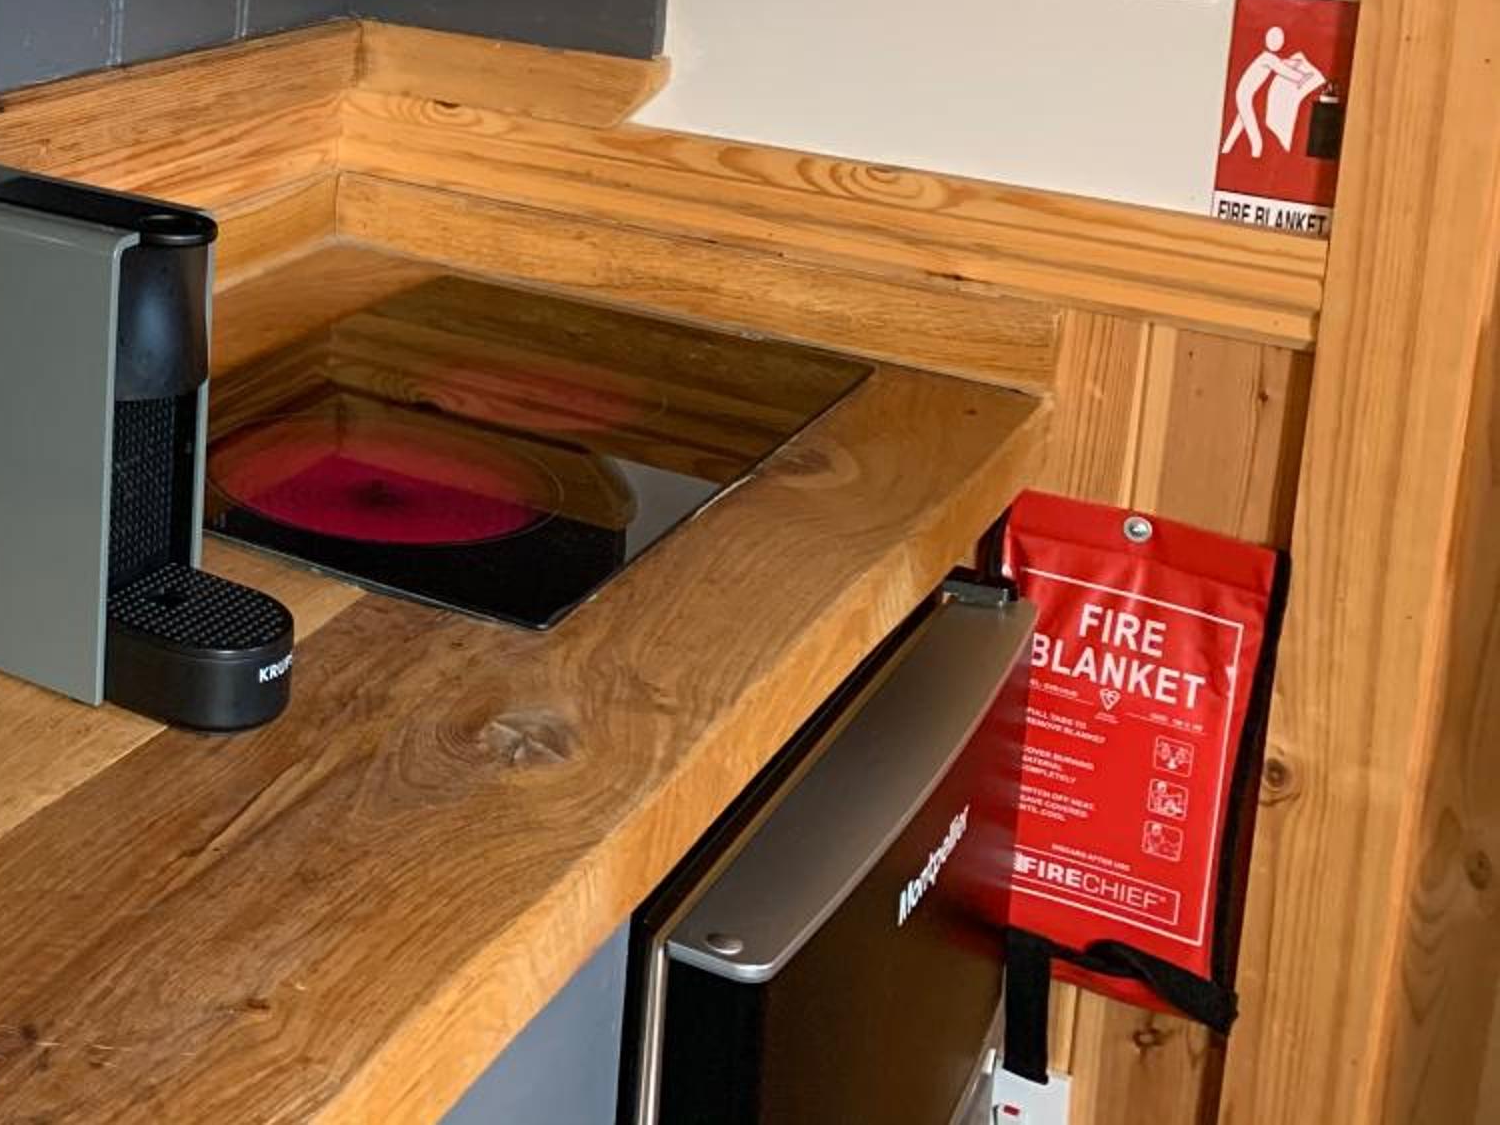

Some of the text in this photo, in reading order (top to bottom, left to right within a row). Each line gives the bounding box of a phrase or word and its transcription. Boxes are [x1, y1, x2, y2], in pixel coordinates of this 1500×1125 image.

[1217, 199, 1328, 236] FIRE BLANKET
[1078, 603, 1167, 658] FIRE
[259, 653, 293, 683] KRUP
[1030, 632, 1206, 710] BLANKET
